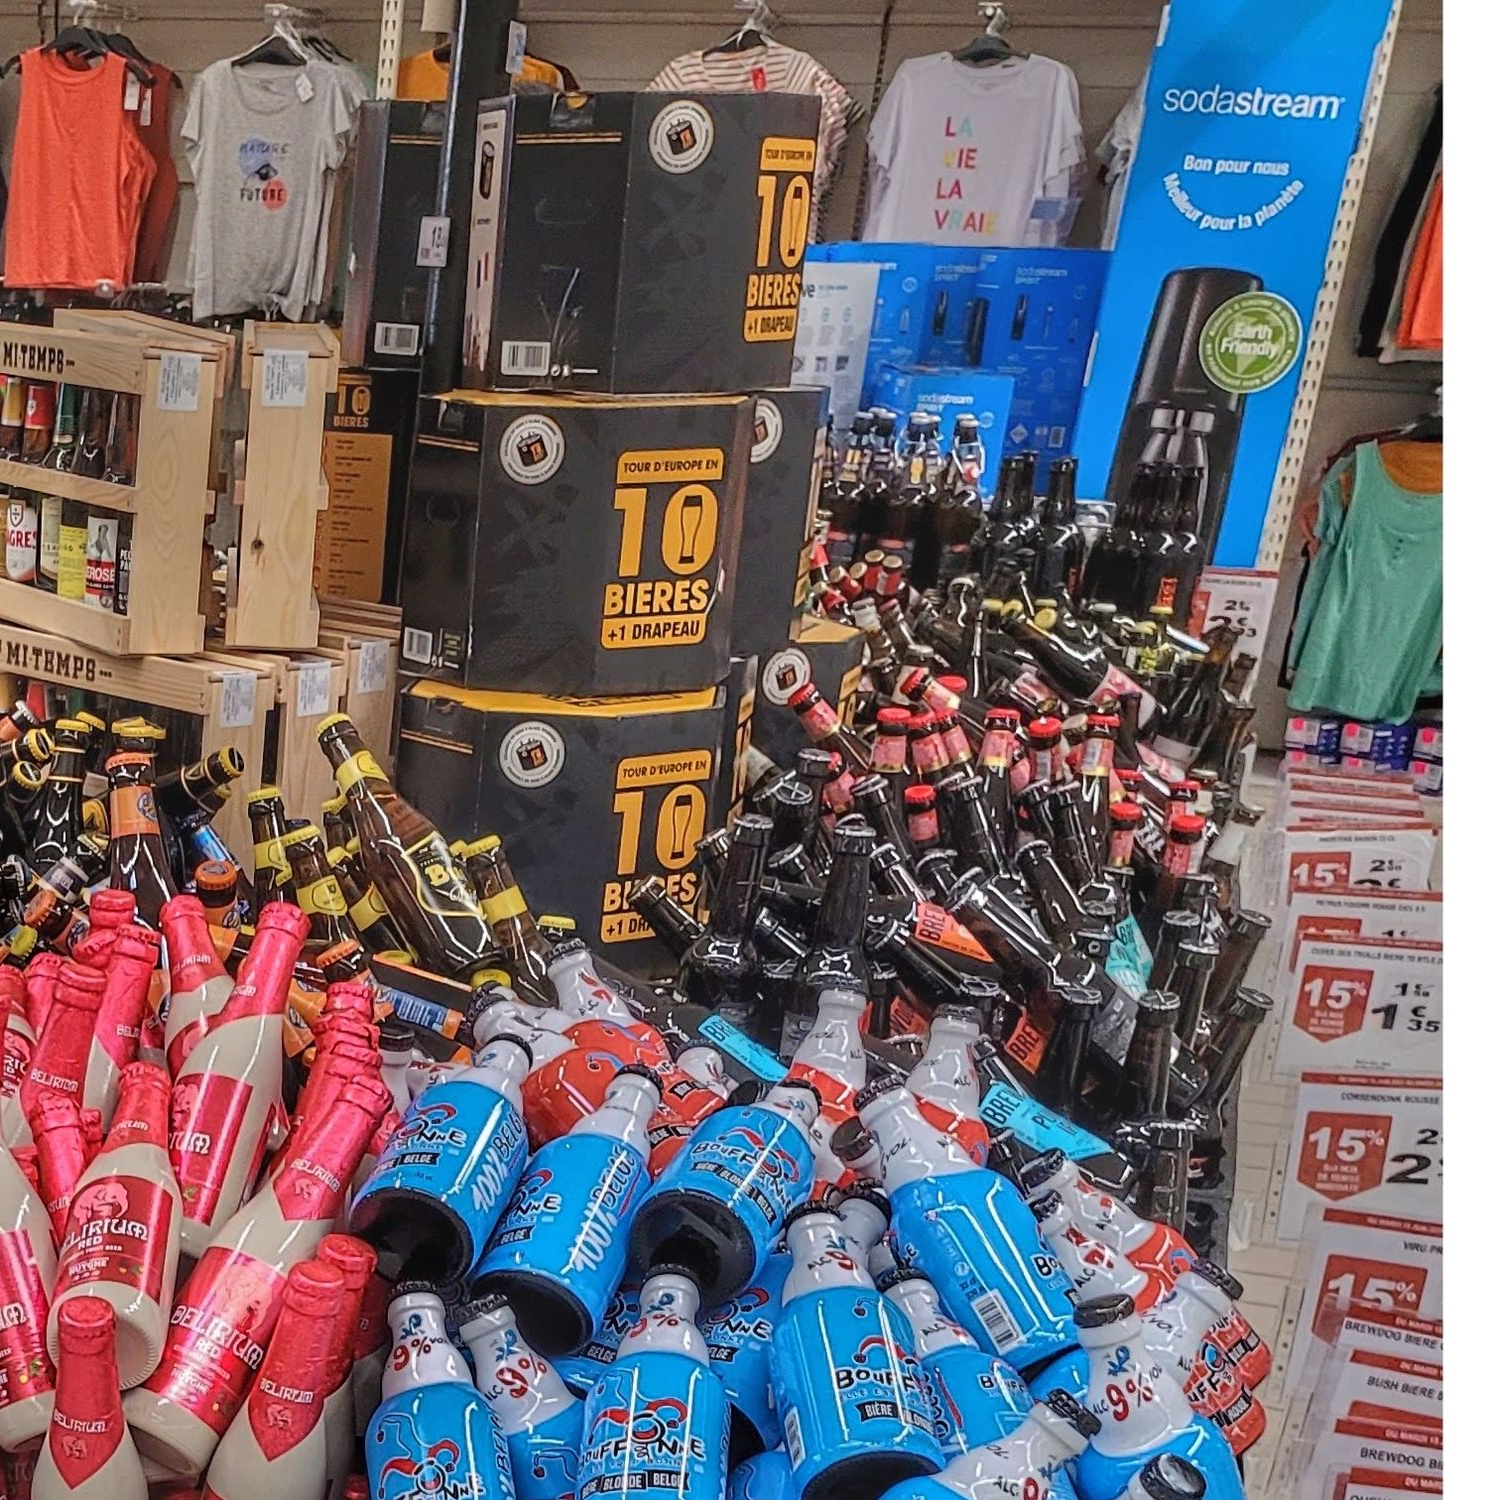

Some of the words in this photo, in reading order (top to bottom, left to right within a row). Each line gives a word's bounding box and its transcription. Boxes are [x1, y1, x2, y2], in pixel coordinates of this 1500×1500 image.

[1163, 84, 1342, 120] sodastream
[945, 116, 973, 137] LA
[943, 148, 977, 169] VIE
[1183, 154, 1212, 171] Bon
[1215, 158, 1251, 175] pour
[1252, 161, 1289, 176] nous
[240, 187, 285, 201] FUTURE
[935, 178, 963, 200] LA
[756, 175, 810, 268] 10
[934, 210, 997, 234] VRAIE
[1199, 214, 1236, 230] pour
[1238, 214, 1252, 229] la
[747, 272, 802, 308] BIERES
[1234, 321, 1272, 340] Earth
[1221, 336, 1279, 360] Friendly
[623, 460, 651, 474] TOUR
[654, 458, 703, 473] D'EUROPE
[706, 458, 718, 471] EN
[613, 484, 718, 578] 10
[603, 578, 711, 616] BIERES
[607, 625, 629, 641] +1
[632, 619, 700, 640] DRAPEAU
[623, 766, 647, 779] TOUR
[650, 762, 693, 776] D'EUROPE
[695, 760, 707, 771] EN
[613, 784, 707, 875] 10
[606, 920, 624, 937] +1
[30, 1067, 79, 1092] DELIRIUM
[1403, 1094, 1441, 1106] ROUSSE
[1307, 1126, 1386, 1163] 15%
[291, 1157, 342, 1194] DELIRIUM
[77, 1234, 103, 1252] RED
[68, 1257, 109, 1277] HUYGHE
[170, 1303, 265, 1371] DELIRIUM
[1344, 1320, 1402, 1341] BREWDOG
[1404, 1332, 1438, 1350] BIERE
[195, 1337, 220, 1357] RED
[258, 1376, 315, 1404] DELIRIUM
[1366, 1375, 1399, 1391] BUSH
[1400, 1382, 1435, 1400] BIERE
[864, 1402, 894, 1419] BIÈRE
[52, 1410, 108, 1434] DELIRIUM
[1360, 1447, 1427, 1467] BREWDOG
[601, 1475, 645, 1491] BLONDE
[652, 1472, 685, 1488] BELGE
